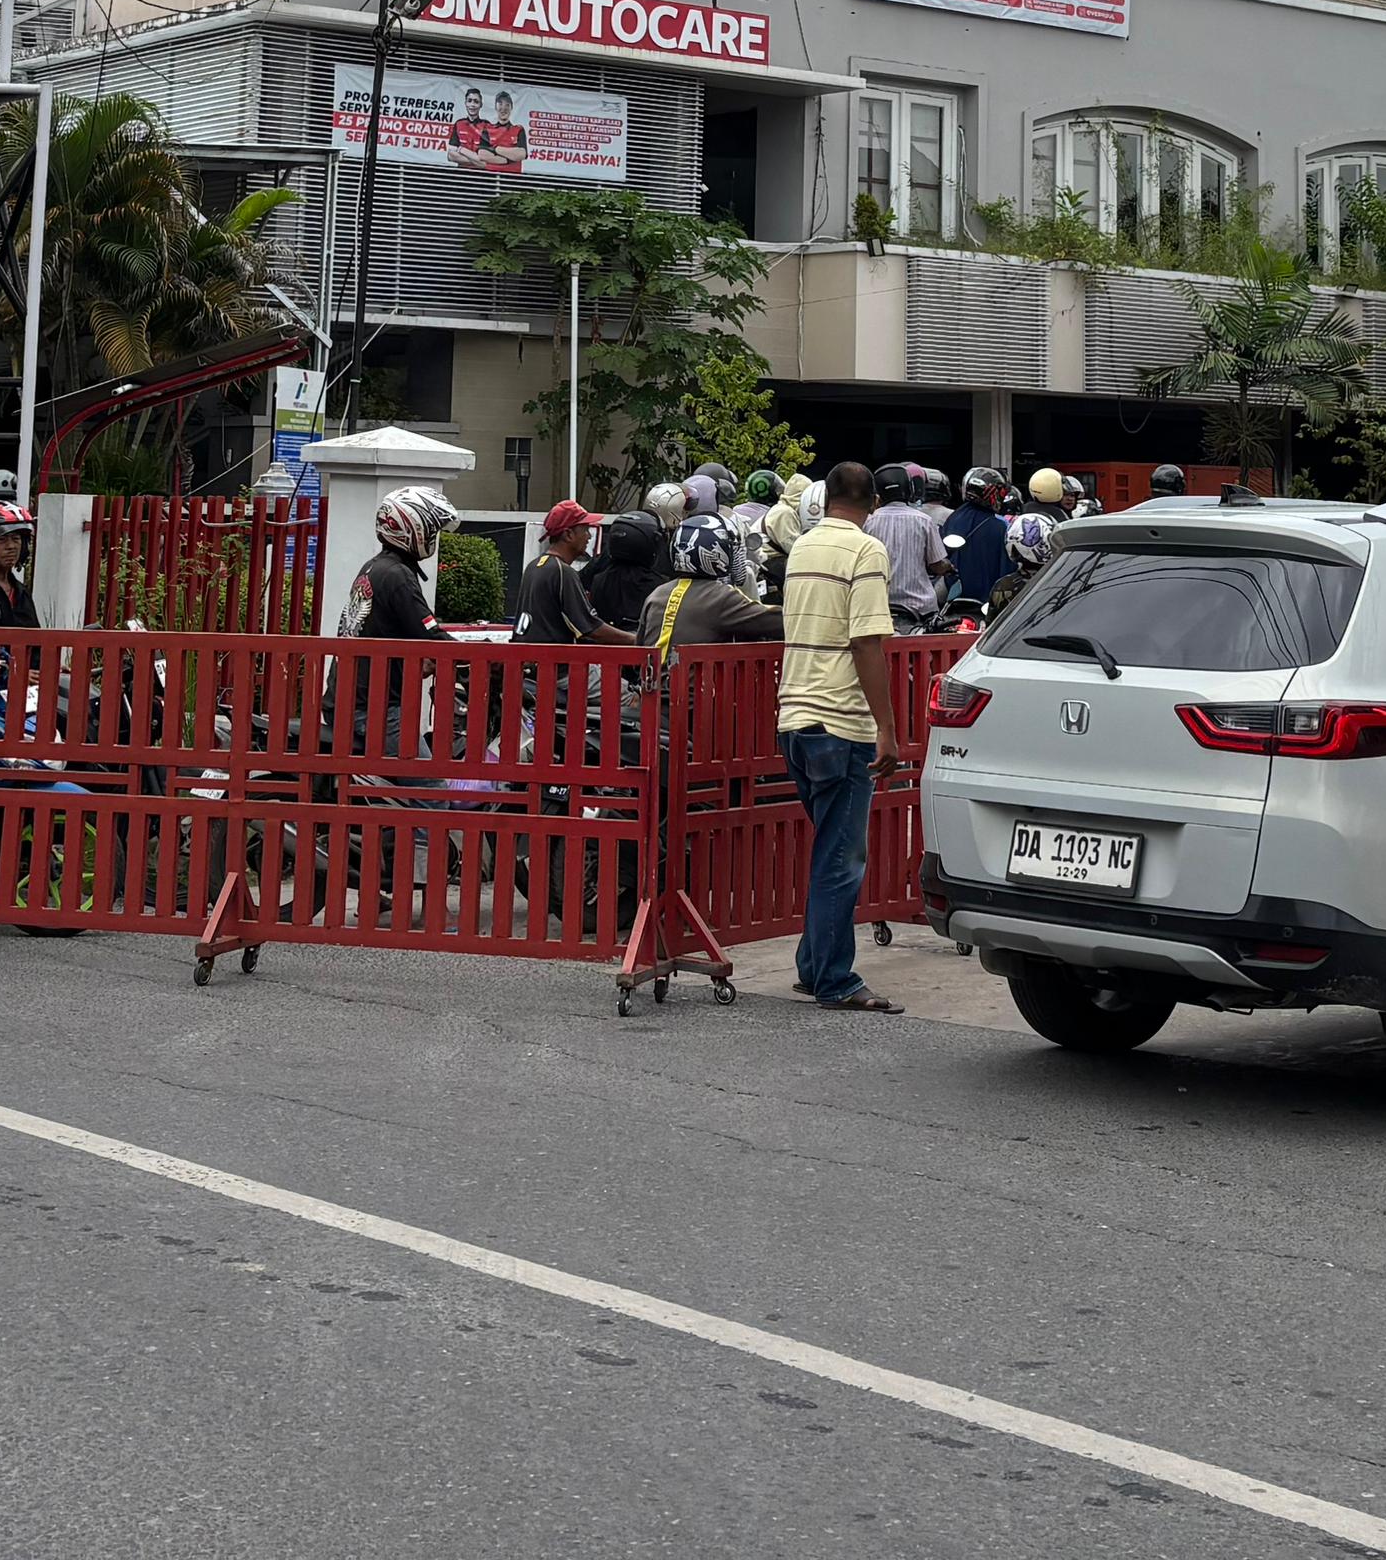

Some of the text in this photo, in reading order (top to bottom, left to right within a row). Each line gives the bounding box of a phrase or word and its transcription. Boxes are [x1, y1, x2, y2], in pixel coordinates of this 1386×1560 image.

[339, 101, 454, 123] SERVCE KAKI KAKI
[344, 90, 455, 112] PROO TERBESAR
[338, 114, 353, 126] 25
[405, 121, 450, 137] GRATIS
[345, 130, 447, 152] SENLAI 5 JUTA
[529, 148, 622, 168] #SEPUASNYA!
[663, 588, 682, 630] RSENAL
[940, 744, 969, 760] BR-V
[1013, 828, 1134, 870] DA 1193 NC
